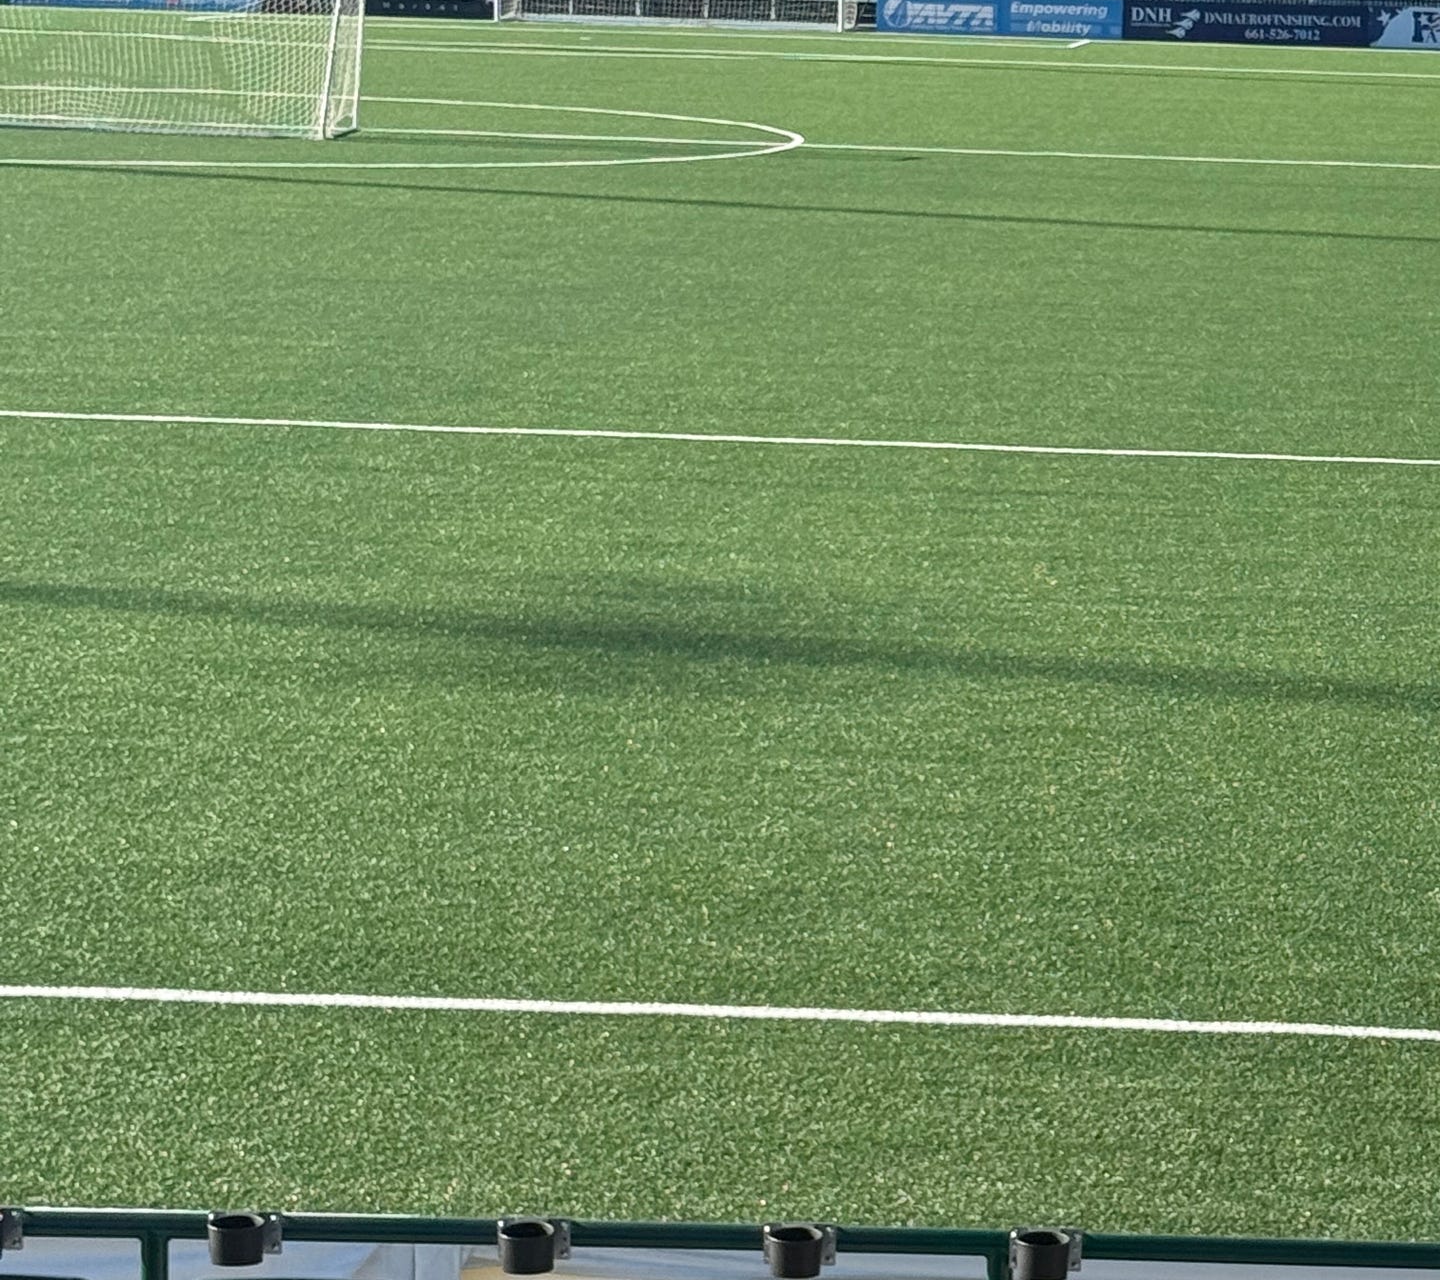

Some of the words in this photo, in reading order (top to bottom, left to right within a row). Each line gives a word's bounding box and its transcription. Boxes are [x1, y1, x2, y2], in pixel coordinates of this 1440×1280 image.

[1010, 1, 1108, 19] Empowering
[1131, 7, 1172, 22] DNH
[1027, 20, 1091, 36] Mobility
